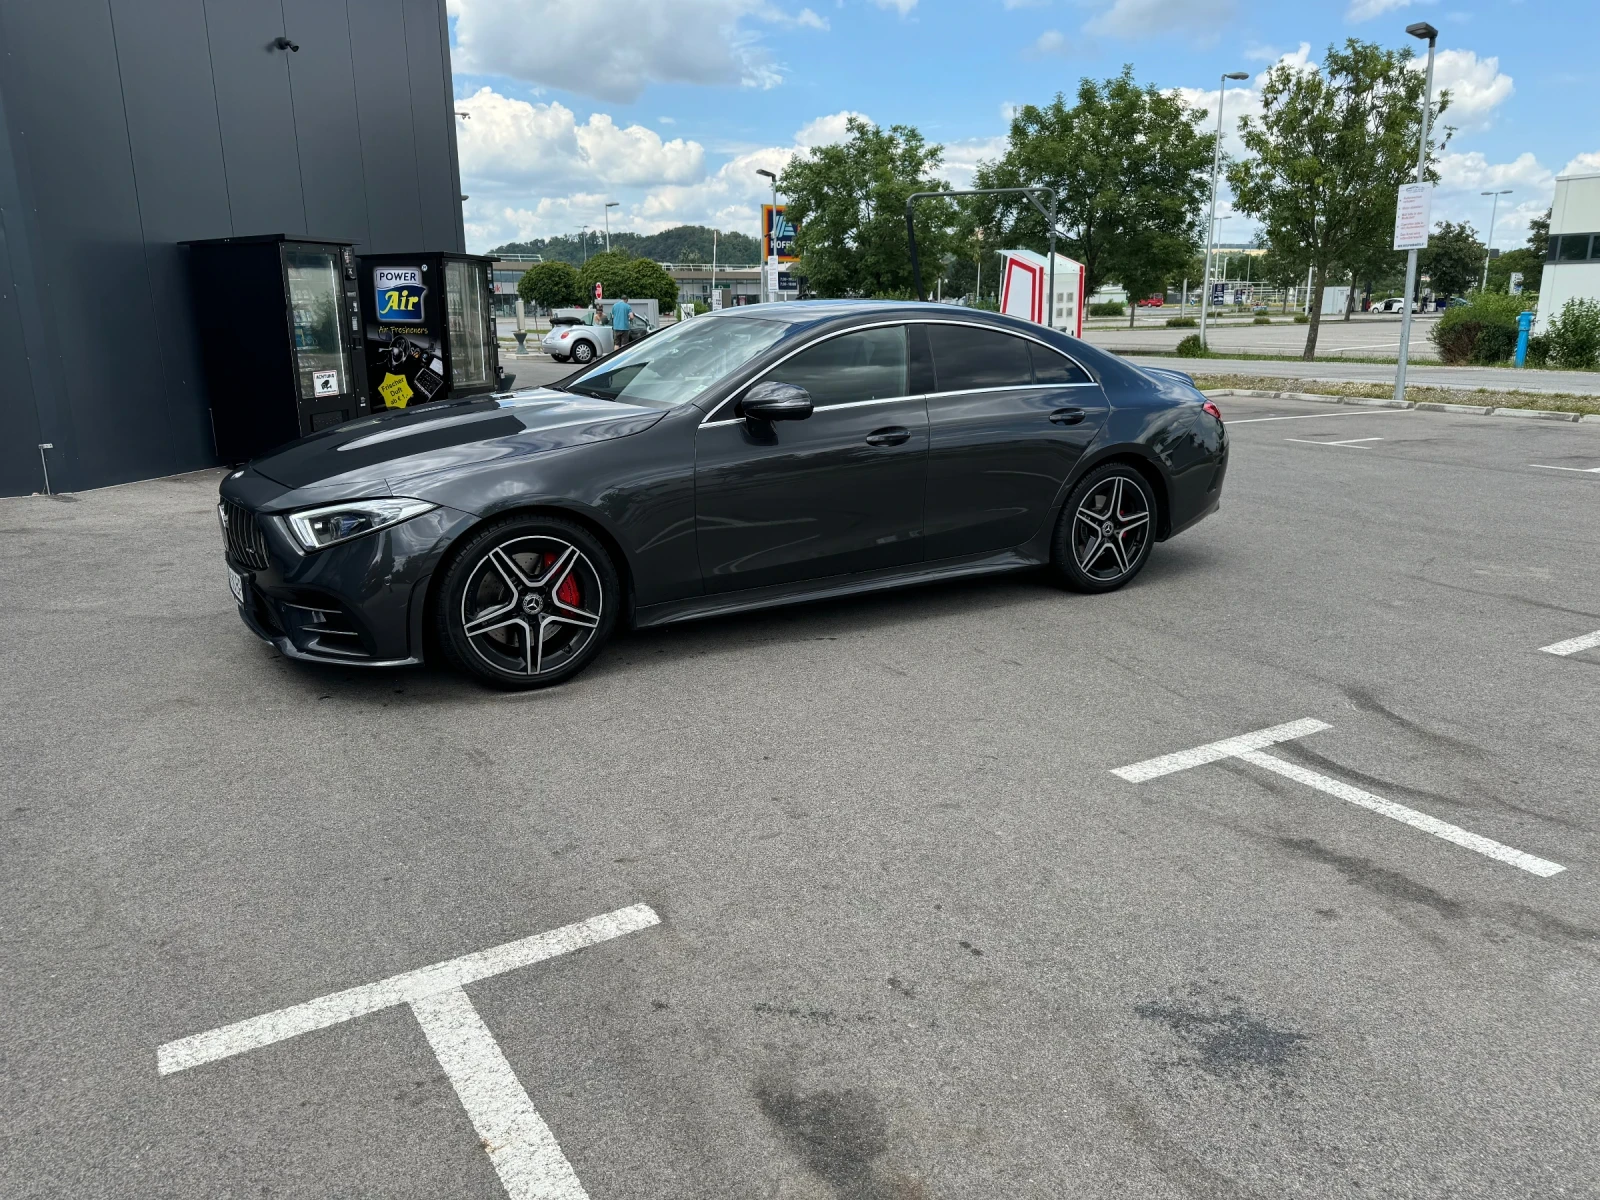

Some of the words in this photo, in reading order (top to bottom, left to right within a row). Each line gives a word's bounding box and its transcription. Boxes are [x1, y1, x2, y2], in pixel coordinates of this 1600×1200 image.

[379, 272, 417, 281] POWER
[379, 290, 419, 314] Air
[378, 326, 389, 334] Air
[389, 325, 428, 334] Fresheners
[381, 377, 404, 392] Frischer
[390, 387, 403, 397] Duft
